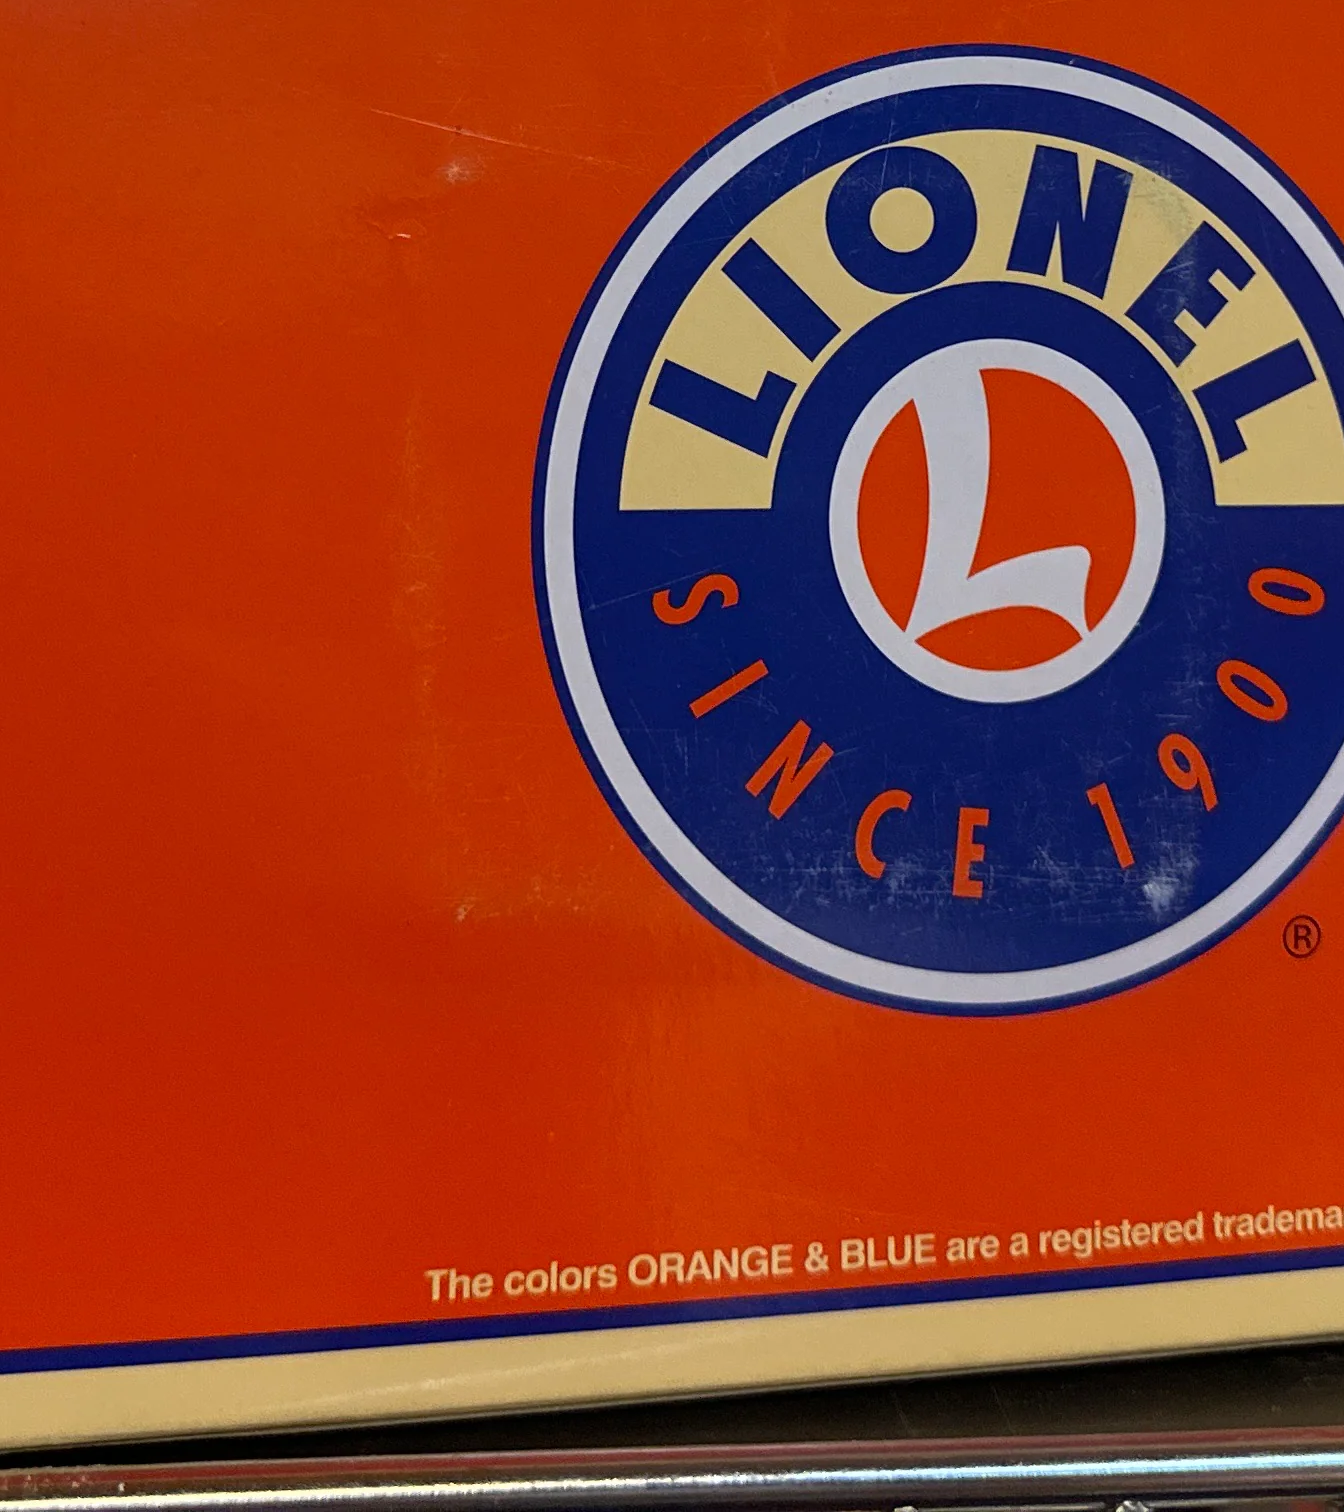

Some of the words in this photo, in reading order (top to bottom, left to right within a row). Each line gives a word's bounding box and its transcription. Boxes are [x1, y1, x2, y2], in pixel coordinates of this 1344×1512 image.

[648, 144, 1317, 464] LIONEL
[651, 572, 990, 899] SINCE
[1086, 566, 1327, 871] 1900
[425, 1267, 493, 1302] The
[504, 1260, 617, 1296] colors
[627, 1242, 794, 1287] ORANGE
[804, 1240, 831, 1272] &
[840, 1233, 937, 1271] BLUE
[946, 1230, 1000, 1262] are
[1009, 1231, 1029, 1255] a
[1039, 1210, 1205, 1260] registered
